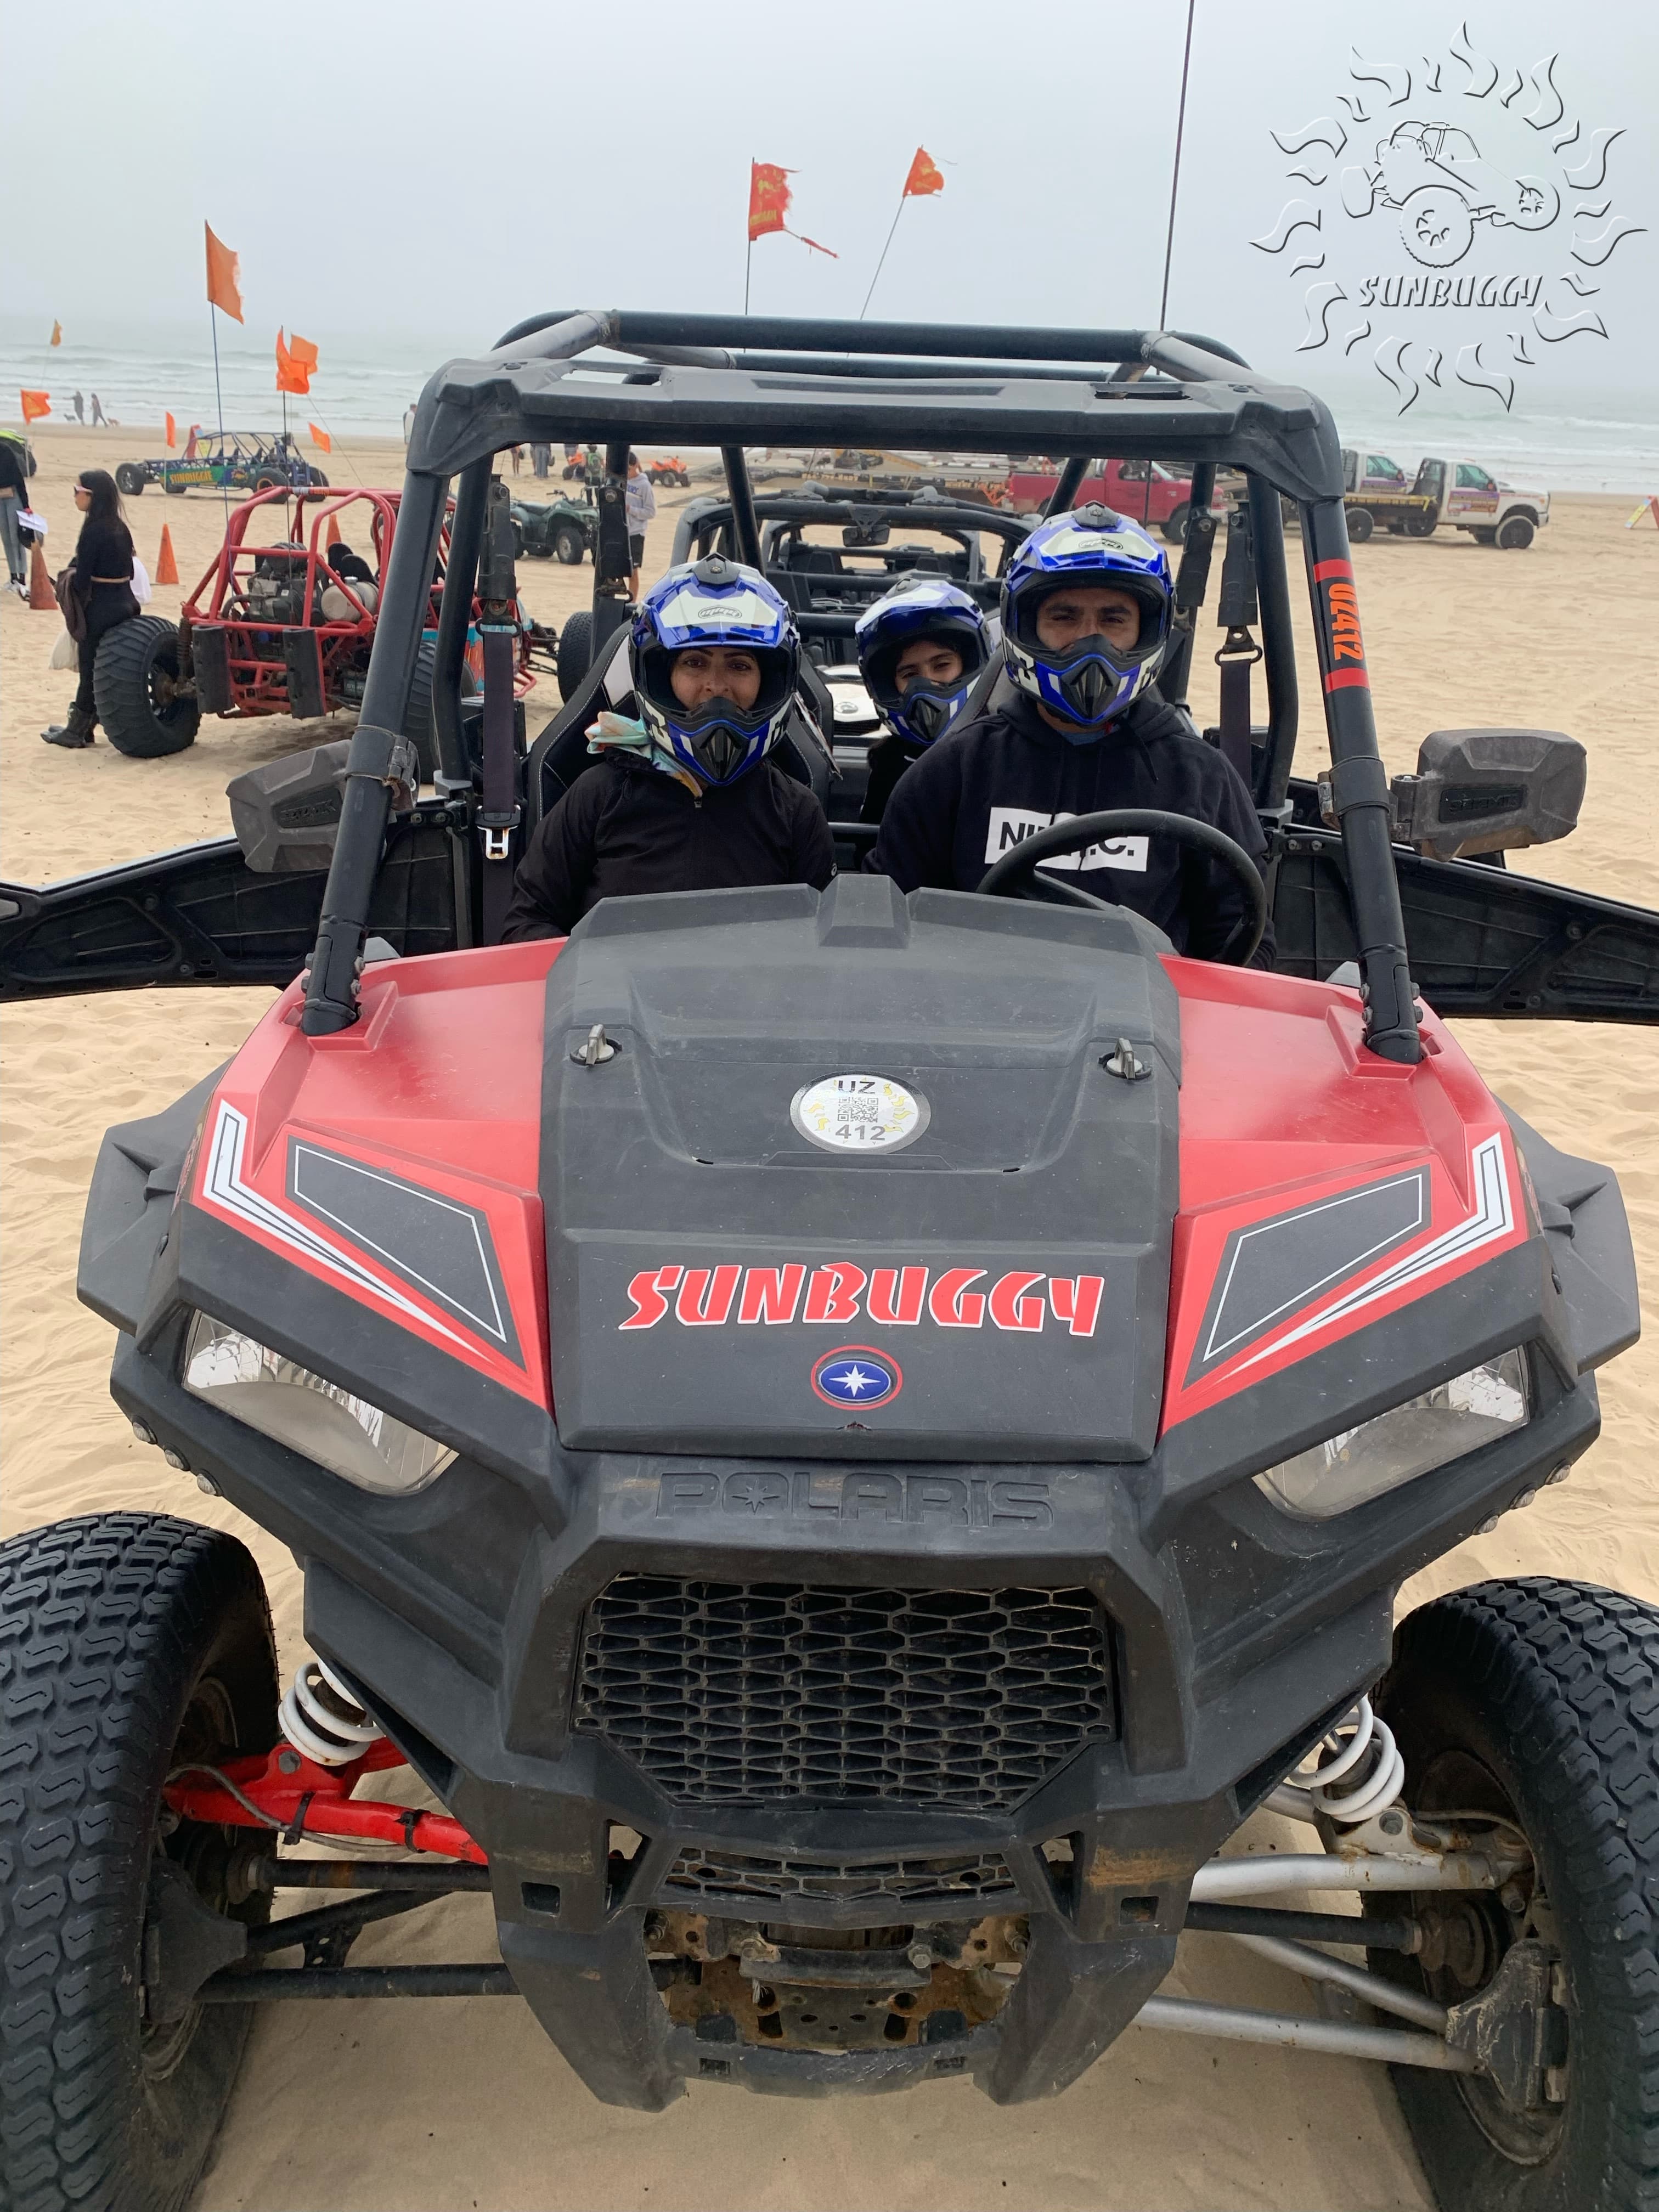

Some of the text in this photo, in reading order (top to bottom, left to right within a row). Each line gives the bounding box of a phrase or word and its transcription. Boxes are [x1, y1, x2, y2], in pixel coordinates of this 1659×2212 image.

[838, 1080, 876, 1094] UZ
[835, 1124, 885, 1141] 412
[618, 1261, 1104, 1337] SUNBUGGY
[656, 1471, 1054, 1531] POLARIS
